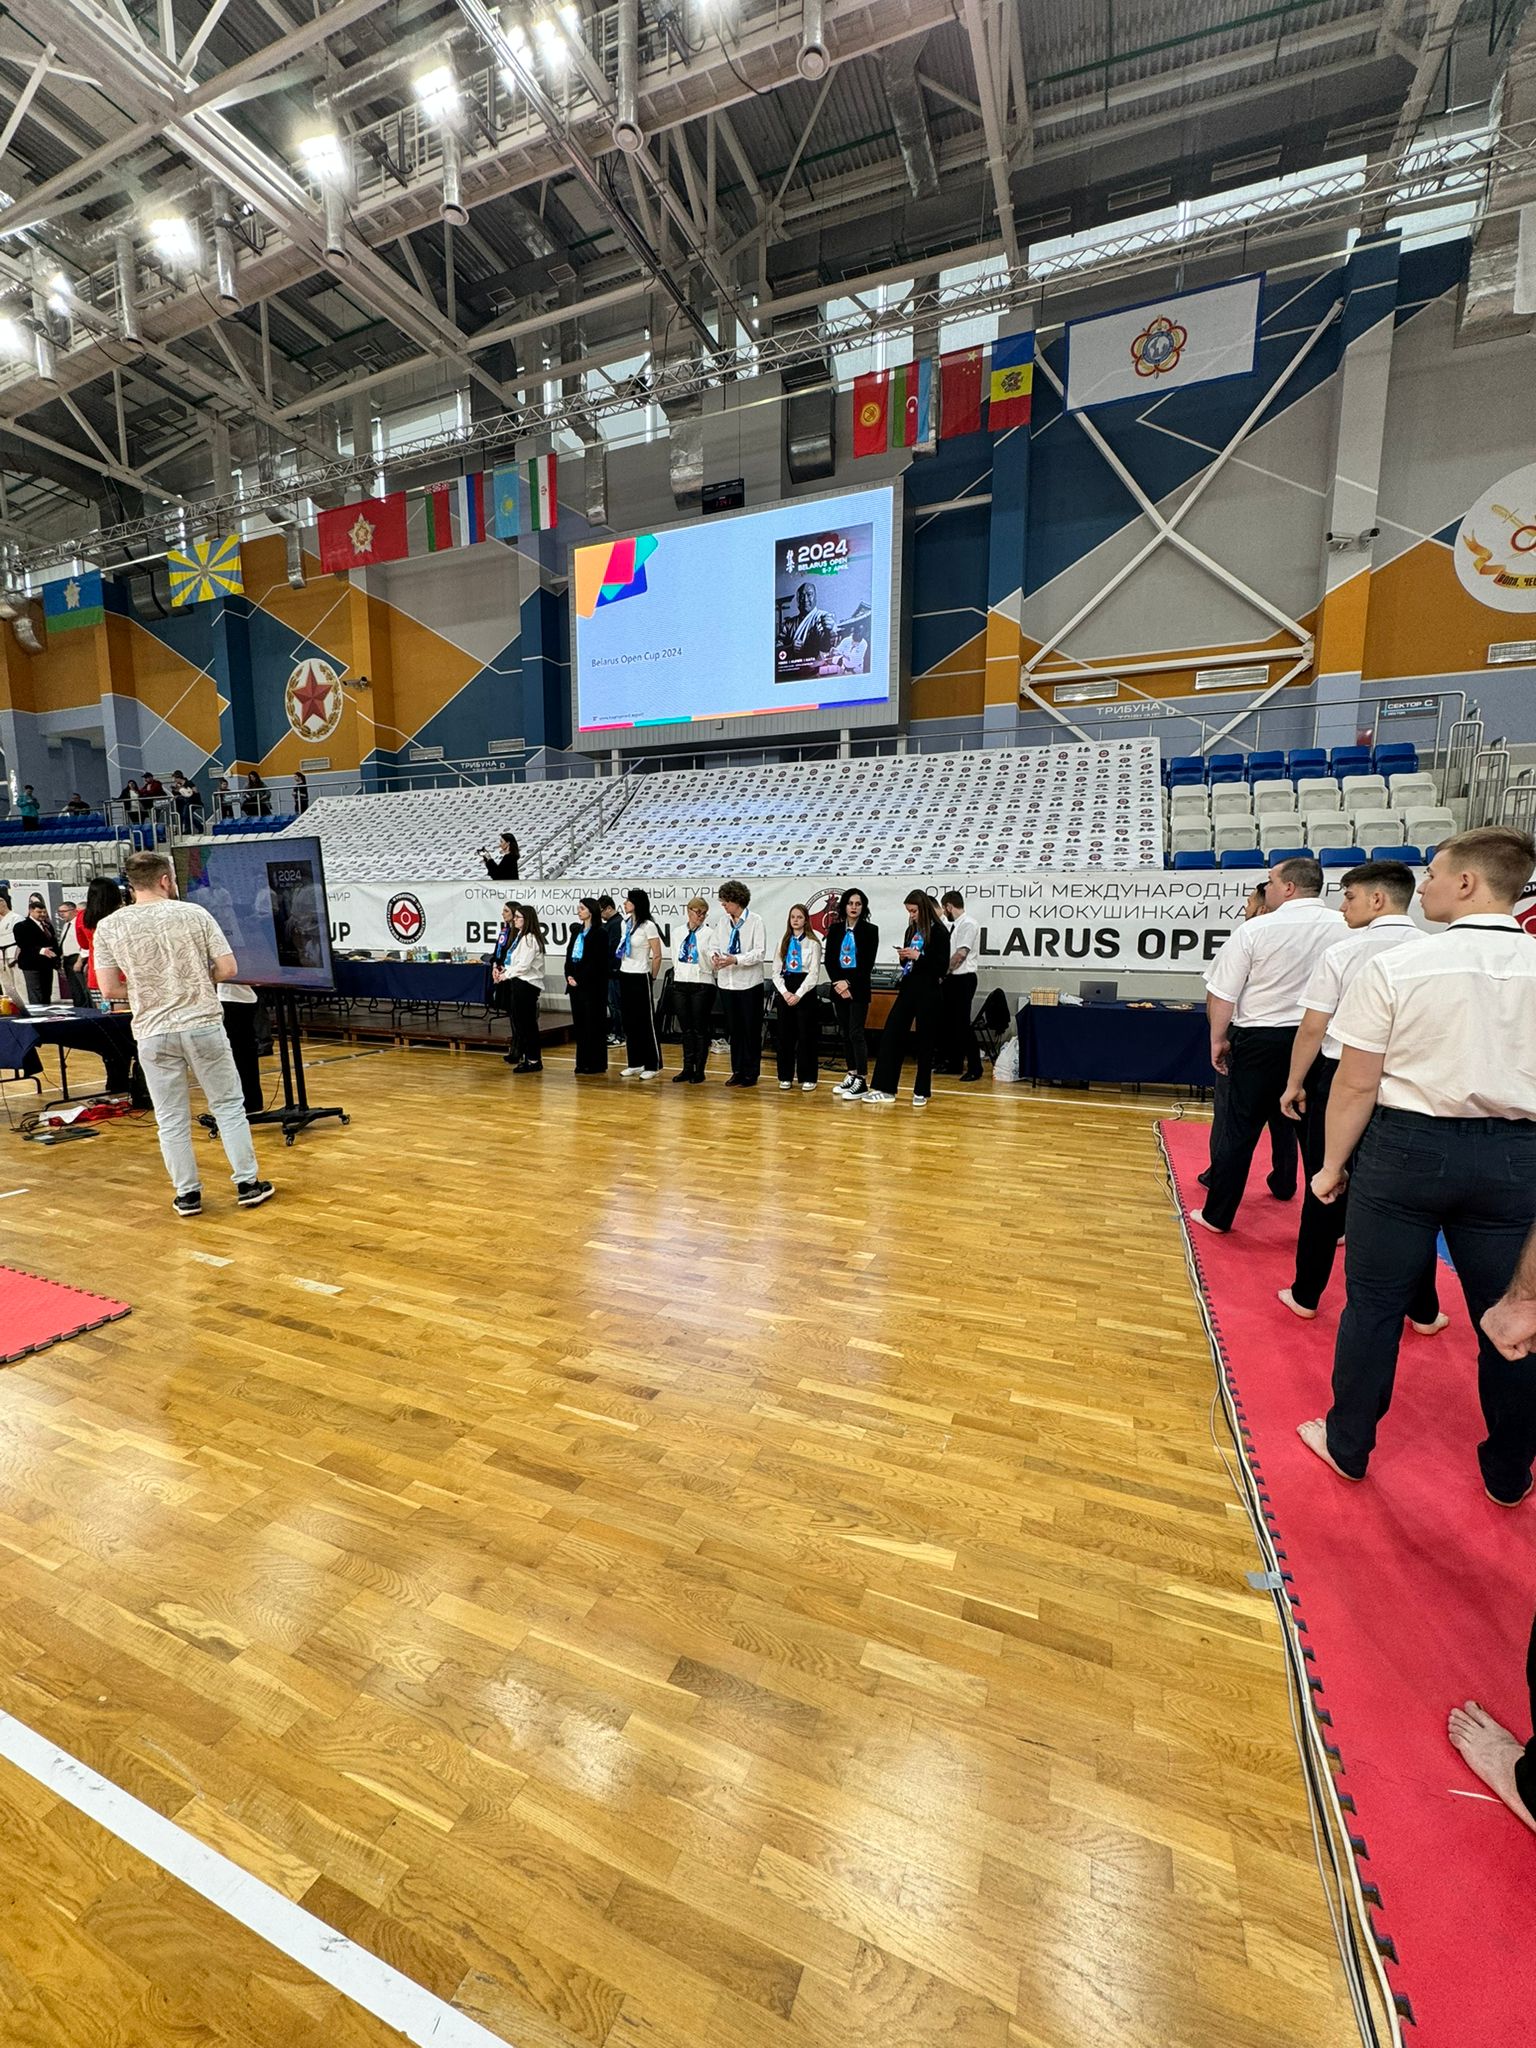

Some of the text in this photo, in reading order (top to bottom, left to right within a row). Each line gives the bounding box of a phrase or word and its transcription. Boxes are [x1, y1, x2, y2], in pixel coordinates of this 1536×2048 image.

[798, 539, 848, 563] 2024
[798, 560, 828, 571] BELARUS
[829, 557, 848, 566] OPEN
[592, 648, 682, 667] Belarus Open Cup 2024
[1096, 702, 1160, 715] ТРИБУНА
[460, 760, 497, 769] ТРИБУНА
[278, 870, 302, 882] 2024
[465, 885, 721, 901] ОТКРЫТЫЙ МЕЖДУНАРОНЫЙ ТУРН
[991, 904, 1020, 919] ПО
[1029, 902, 1208, 920] КИОКУШИНКАЙ
[979, 926, 1231, 961] LARUS OPE
